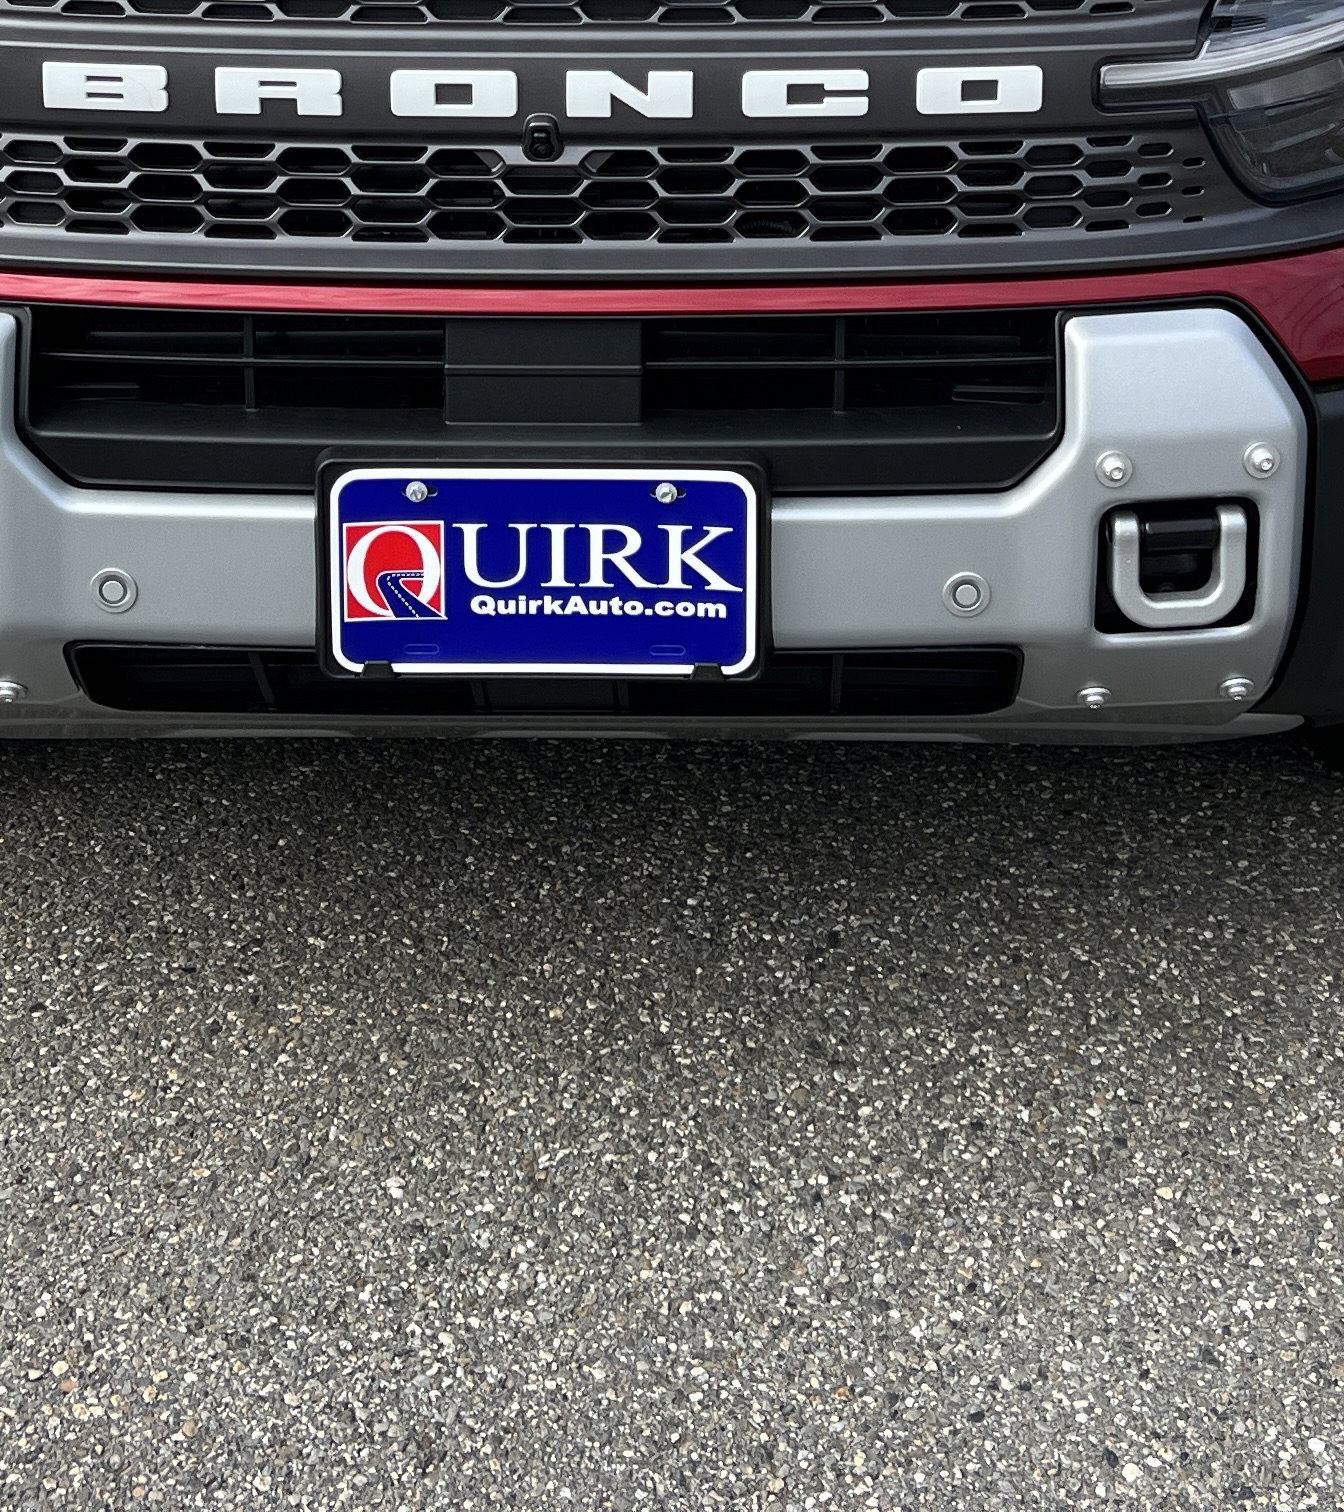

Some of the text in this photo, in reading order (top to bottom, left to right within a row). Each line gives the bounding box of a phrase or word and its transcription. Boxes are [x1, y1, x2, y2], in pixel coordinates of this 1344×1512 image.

[42, 61, 1043, 119] BRONCO
[346, 523, 744, 619] QUIRK
[470, 594, 727, 619] QuirkAuto.com
